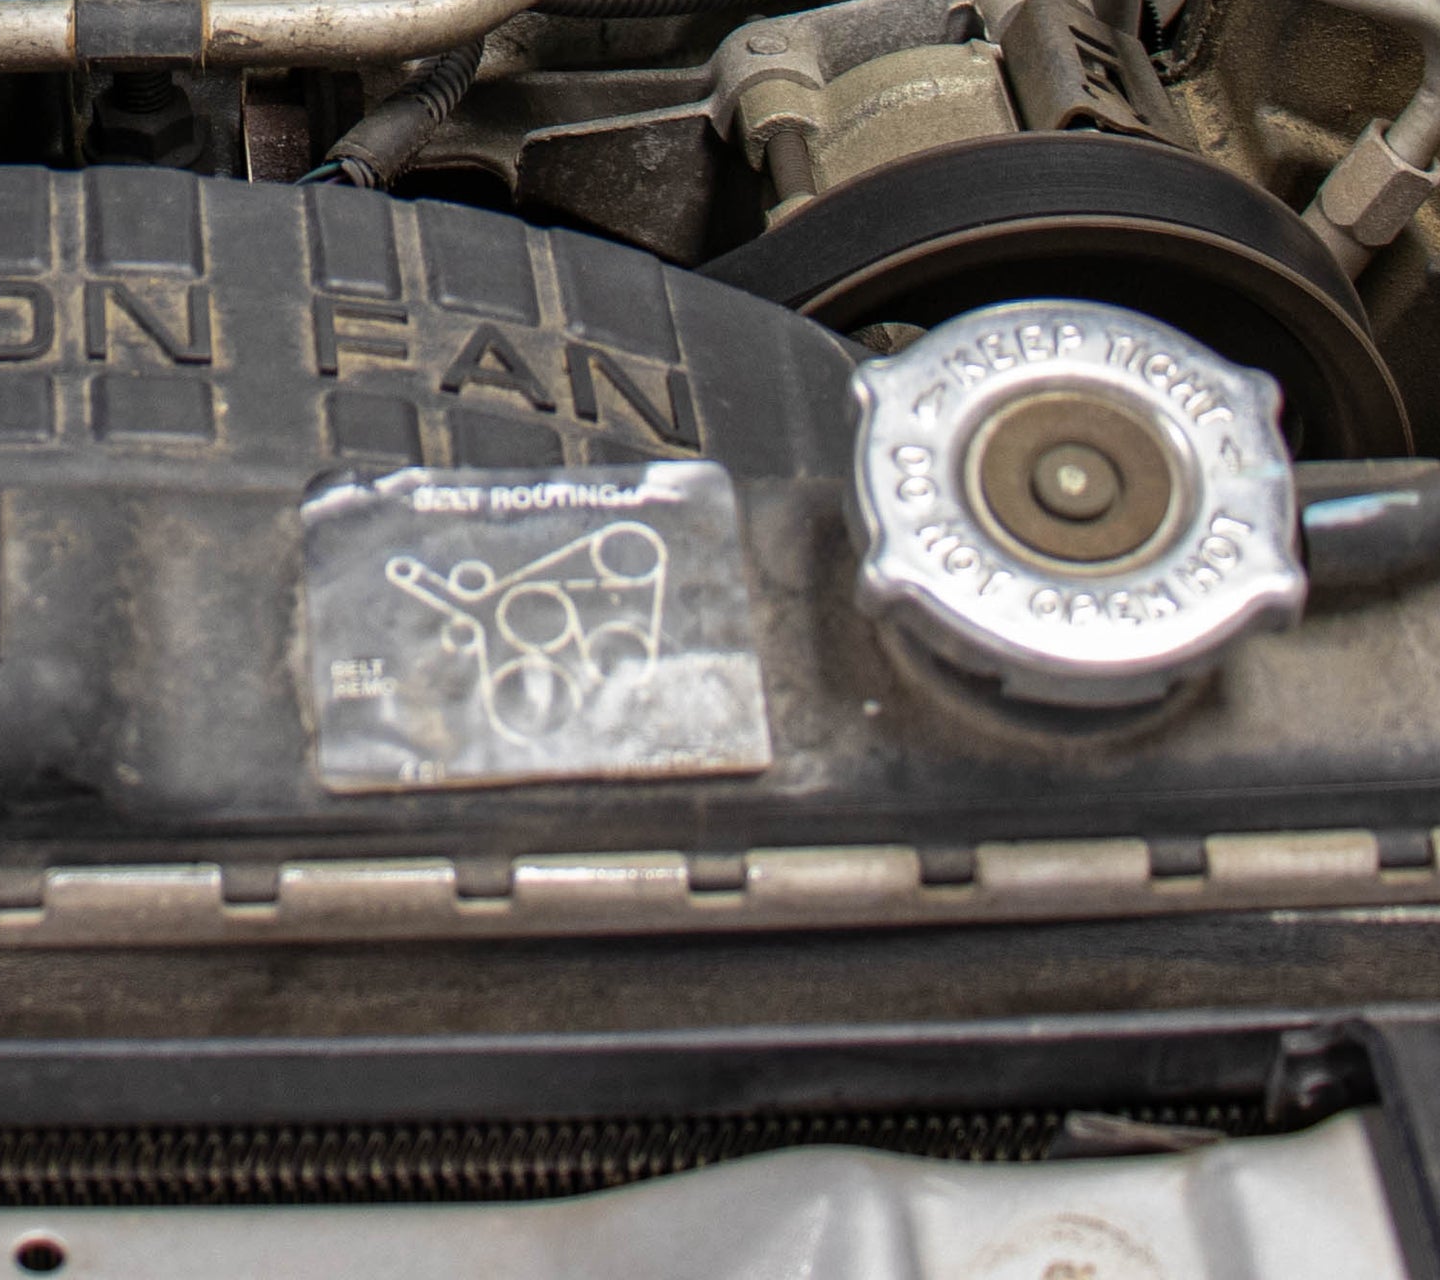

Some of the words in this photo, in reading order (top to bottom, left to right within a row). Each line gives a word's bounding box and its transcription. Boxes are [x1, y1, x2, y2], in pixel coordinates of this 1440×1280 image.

[314, 297, 704, 453] FAN
[944, 323, 1083, 386] KEEP
[1104, 329, 1236, 427] TIGHT
[890, 444, 938, 510] DO
[916, 523, 1014, 597] NOT
[1029, 581, 1180, 628] OPEN
[1175, 512, 1254, 594] HOT
